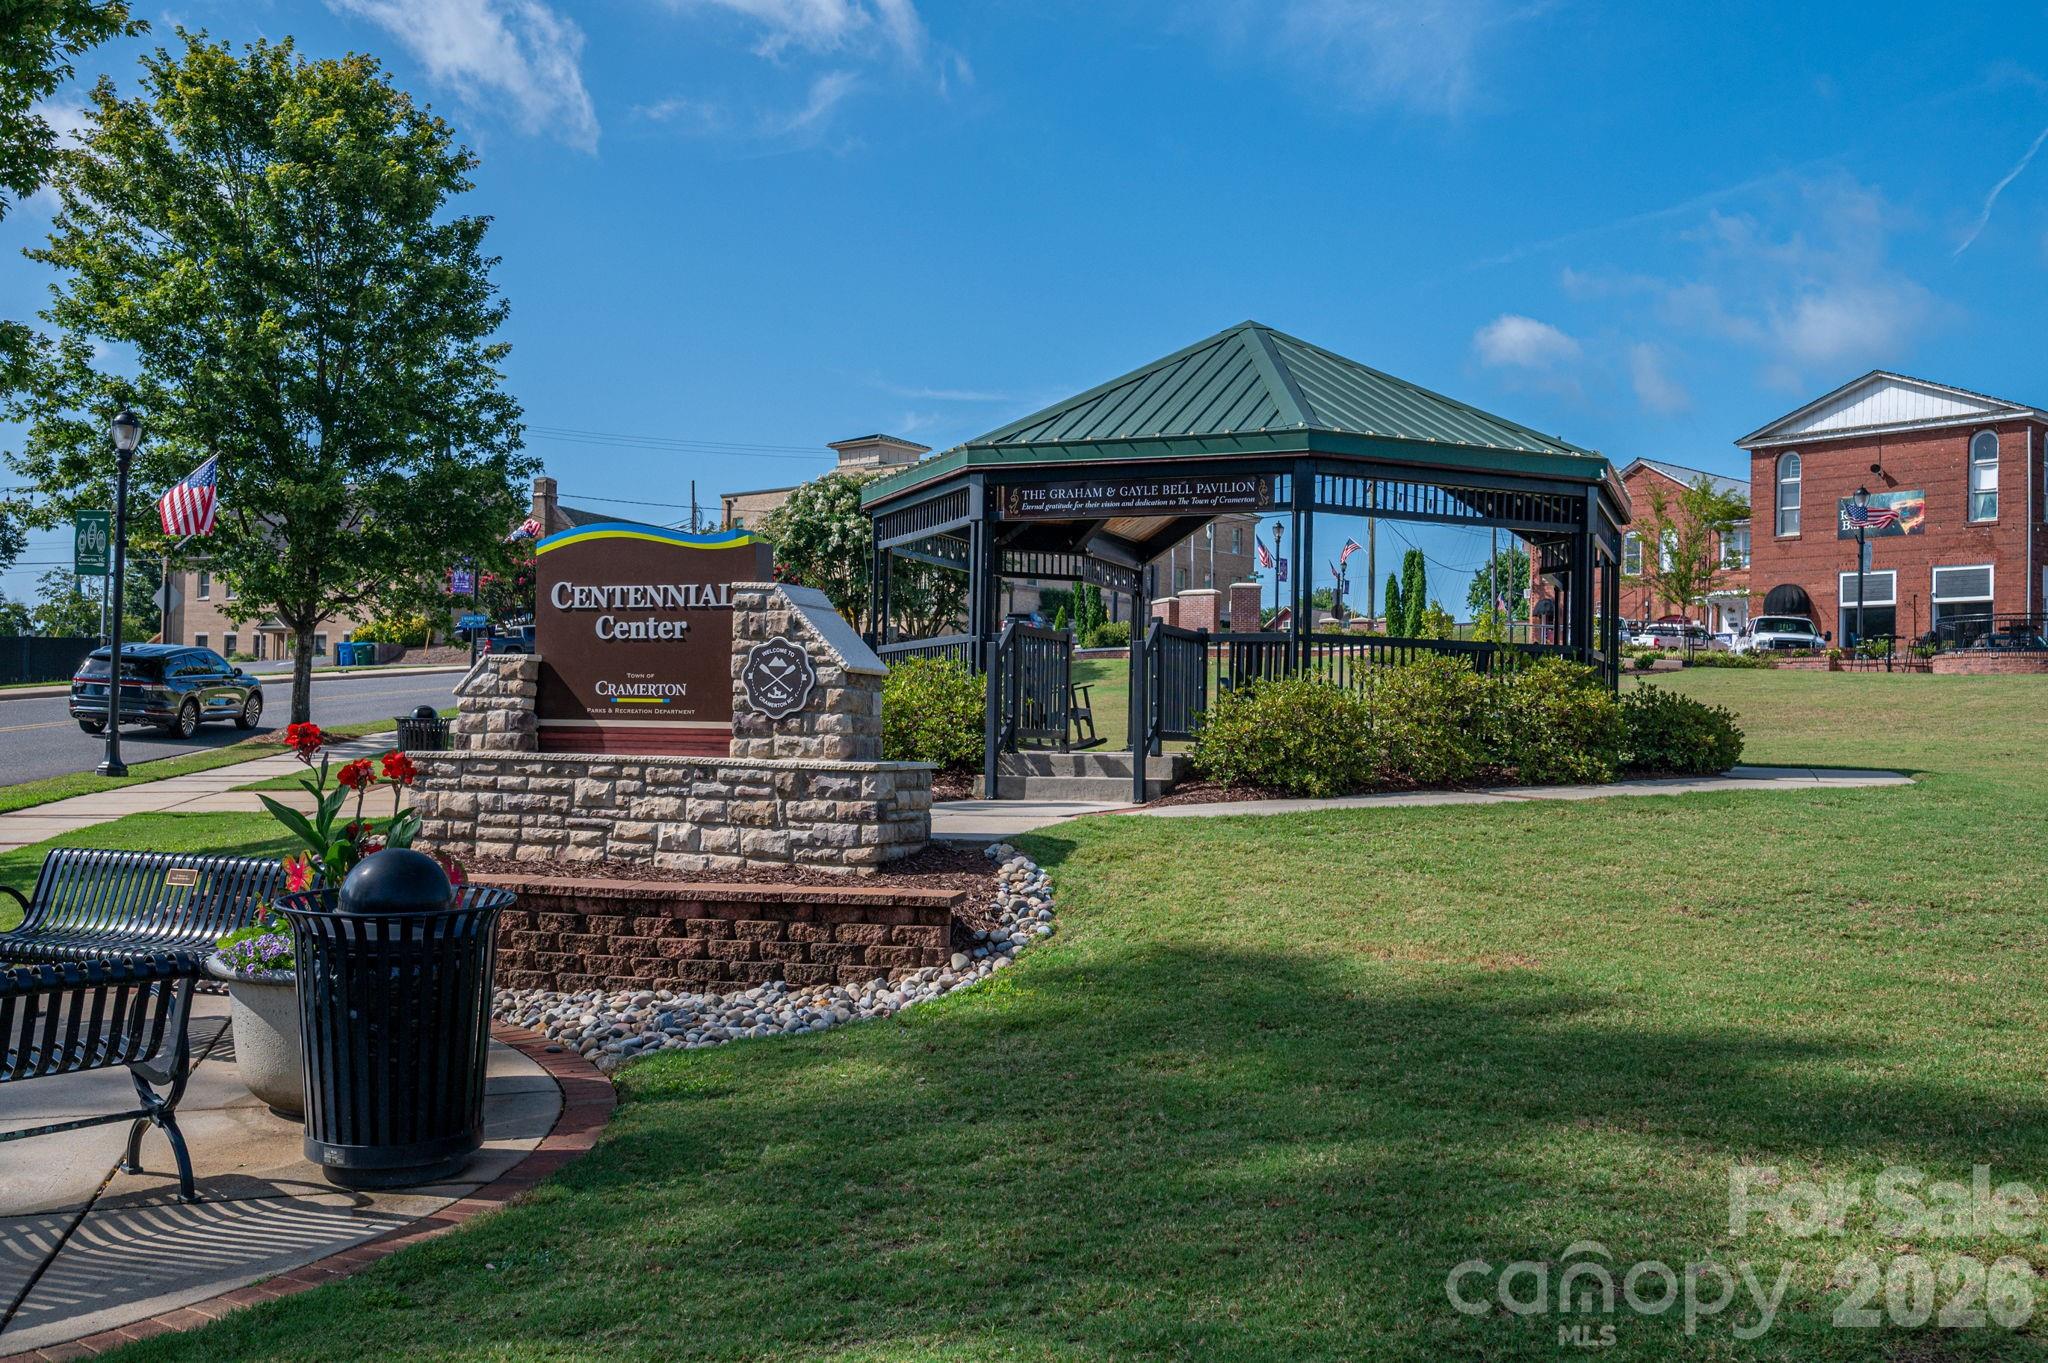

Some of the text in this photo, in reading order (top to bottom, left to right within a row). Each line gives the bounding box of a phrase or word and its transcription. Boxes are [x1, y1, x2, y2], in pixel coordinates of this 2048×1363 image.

[1022, 482, 1255, 500] THE GRAHAM & GAYLE BELL PAVILION
[1022, 502, 1044, 511] Eternal
[1045, 501, 1073, 512] gratitude
[1073, 499, 1084, 511] for
[1121, 499, 1134, 507] and
[1134, 498, 1168, 507] dedication
[1178, 497, 1190, 505] The
[1191, 497, 1209, 505] Town
[1210, 496, 1219, 506] of
[1219, 495, 1256, 504] Cramerton
[551, 581, 734, 610] CENTENNIAL
[595, 615, 688, 640] Center
[762, 648, 787, 656] WELCOME
[595, 680, 687, 696] CRAMERTON
[759, 696, 787, 707] CRAMERTON
